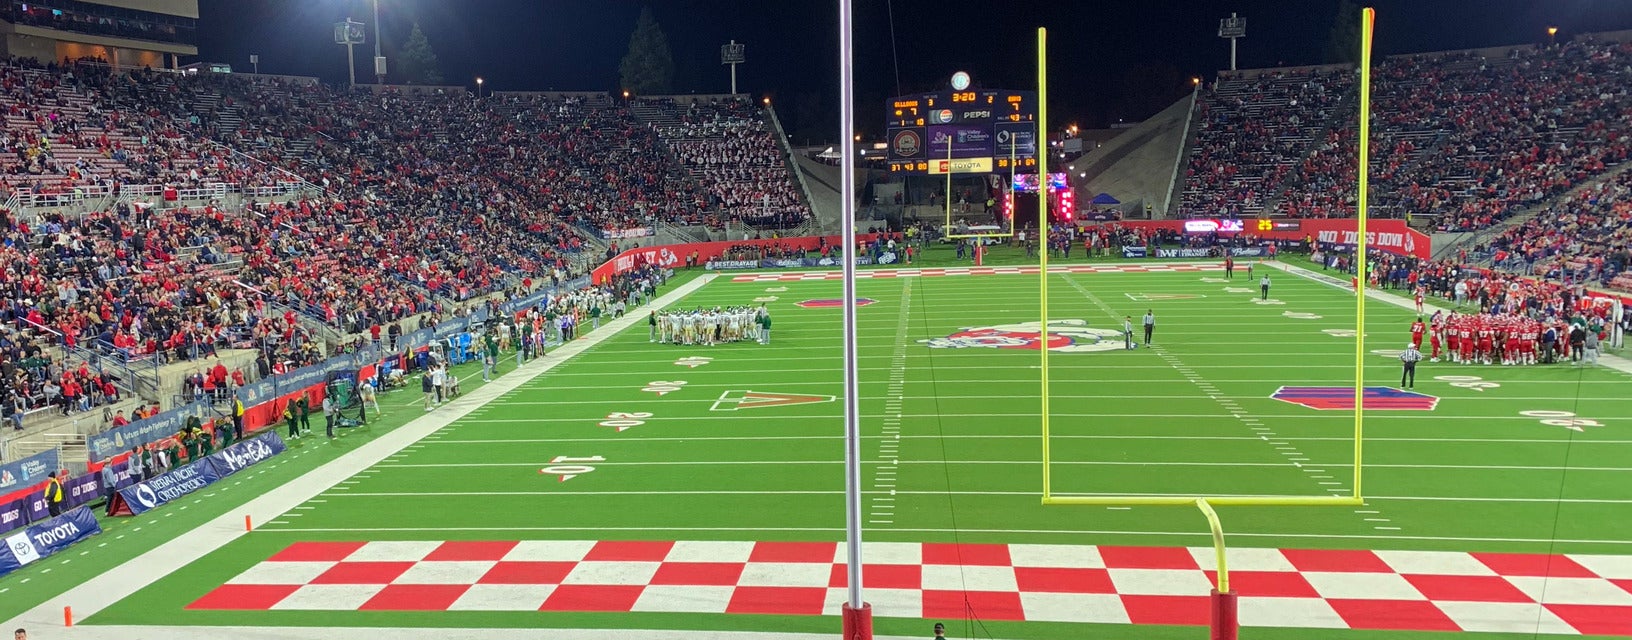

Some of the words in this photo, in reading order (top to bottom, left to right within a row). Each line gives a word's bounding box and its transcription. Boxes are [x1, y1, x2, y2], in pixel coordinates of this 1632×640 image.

[928, 98, 934, 106] 3
[953, 92, 976, 102] 3:20
[910, 107, 917, 116] 7
[1012, 102, 1019, 111] 7
[963, 111, 991, 119] PEPSI
[953, 162, 982, 170] TOYOTA
[1258, 219, 1272, 231] 25
[1318, 230, 1337, 243] NO
[1377, 232, 1403, 247] DOWN
[729, 259, 758, 267] DRAYAGE
[598, 411, 654, 427] 20
[539, 455, 607, 475] 10
[149, 475, 177, 491] SIERRA
[174, 465, 198, 482] PACIFIC
[72, 486, 81, 497] GO
[157, 475, 207, 501] ORTHOPEDICS
[34, 500, 42, 512] GO
[33, 521, 80, 547] TOYOTA
